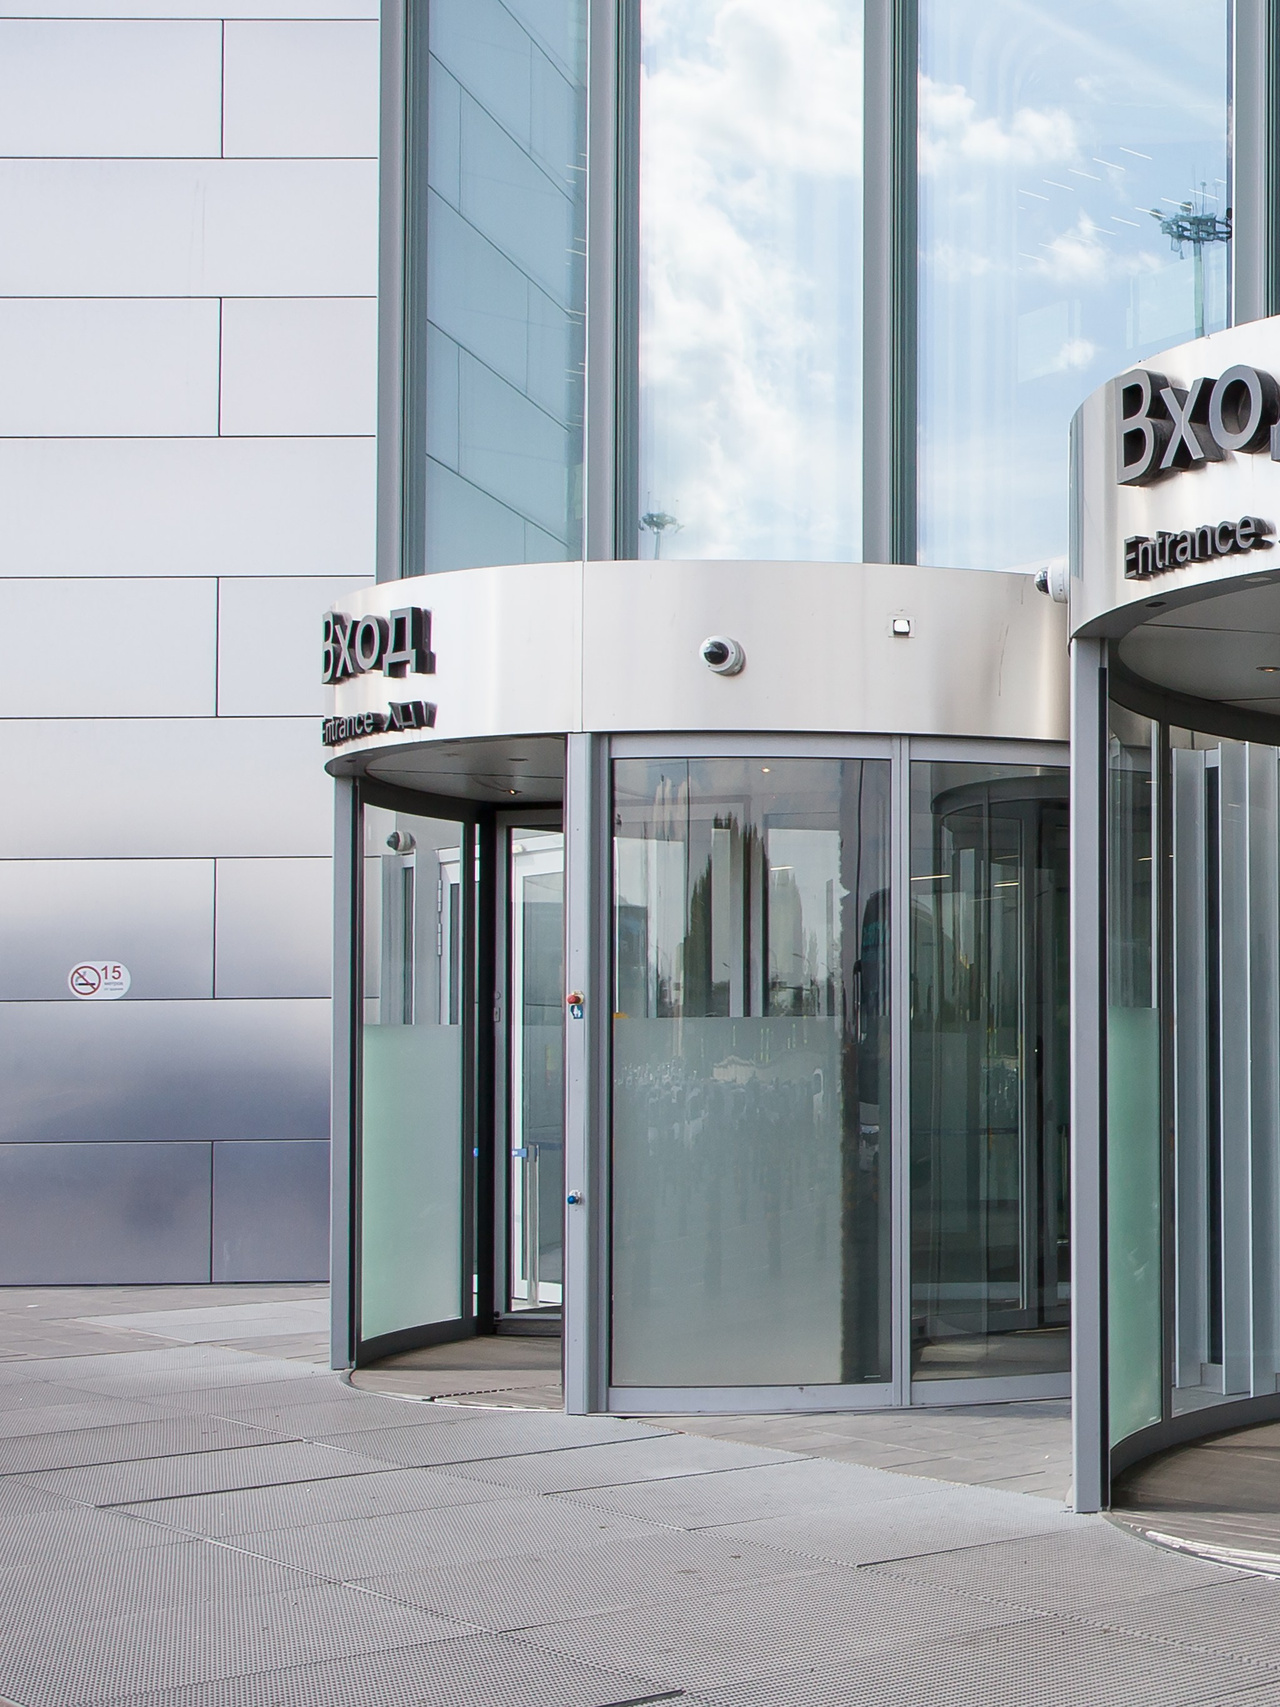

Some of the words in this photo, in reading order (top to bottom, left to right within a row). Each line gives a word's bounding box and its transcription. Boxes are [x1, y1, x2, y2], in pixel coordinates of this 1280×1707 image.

[1124, 515, 1262, 580] Entrance
[321, 711, 377, 746] Entrance
[101, 965, 122, 980] 15
